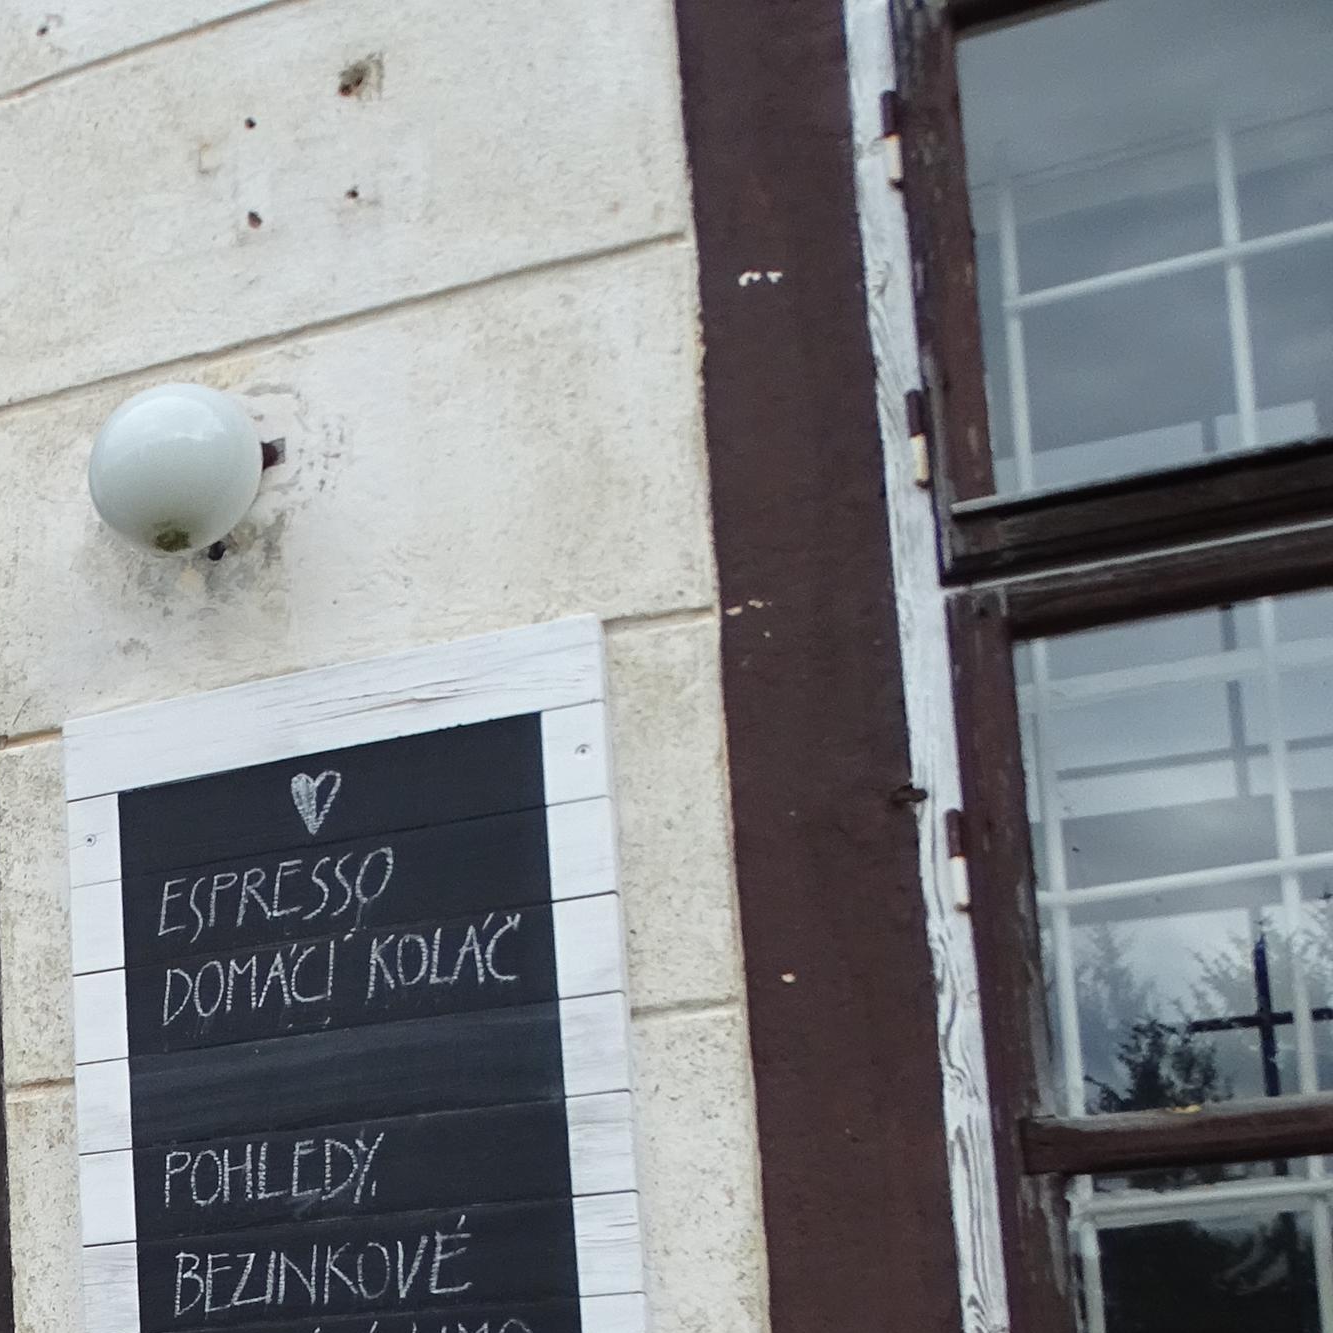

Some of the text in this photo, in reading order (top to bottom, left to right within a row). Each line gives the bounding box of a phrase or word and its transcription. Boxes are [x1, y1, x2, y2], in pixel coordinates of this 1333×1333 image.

[158, 847, 394, 943] ESPRESSO
[365, 912, 521, 1003] KOLÁČ
[174, 1215, 473, 1318] BEZINKOVÉ
